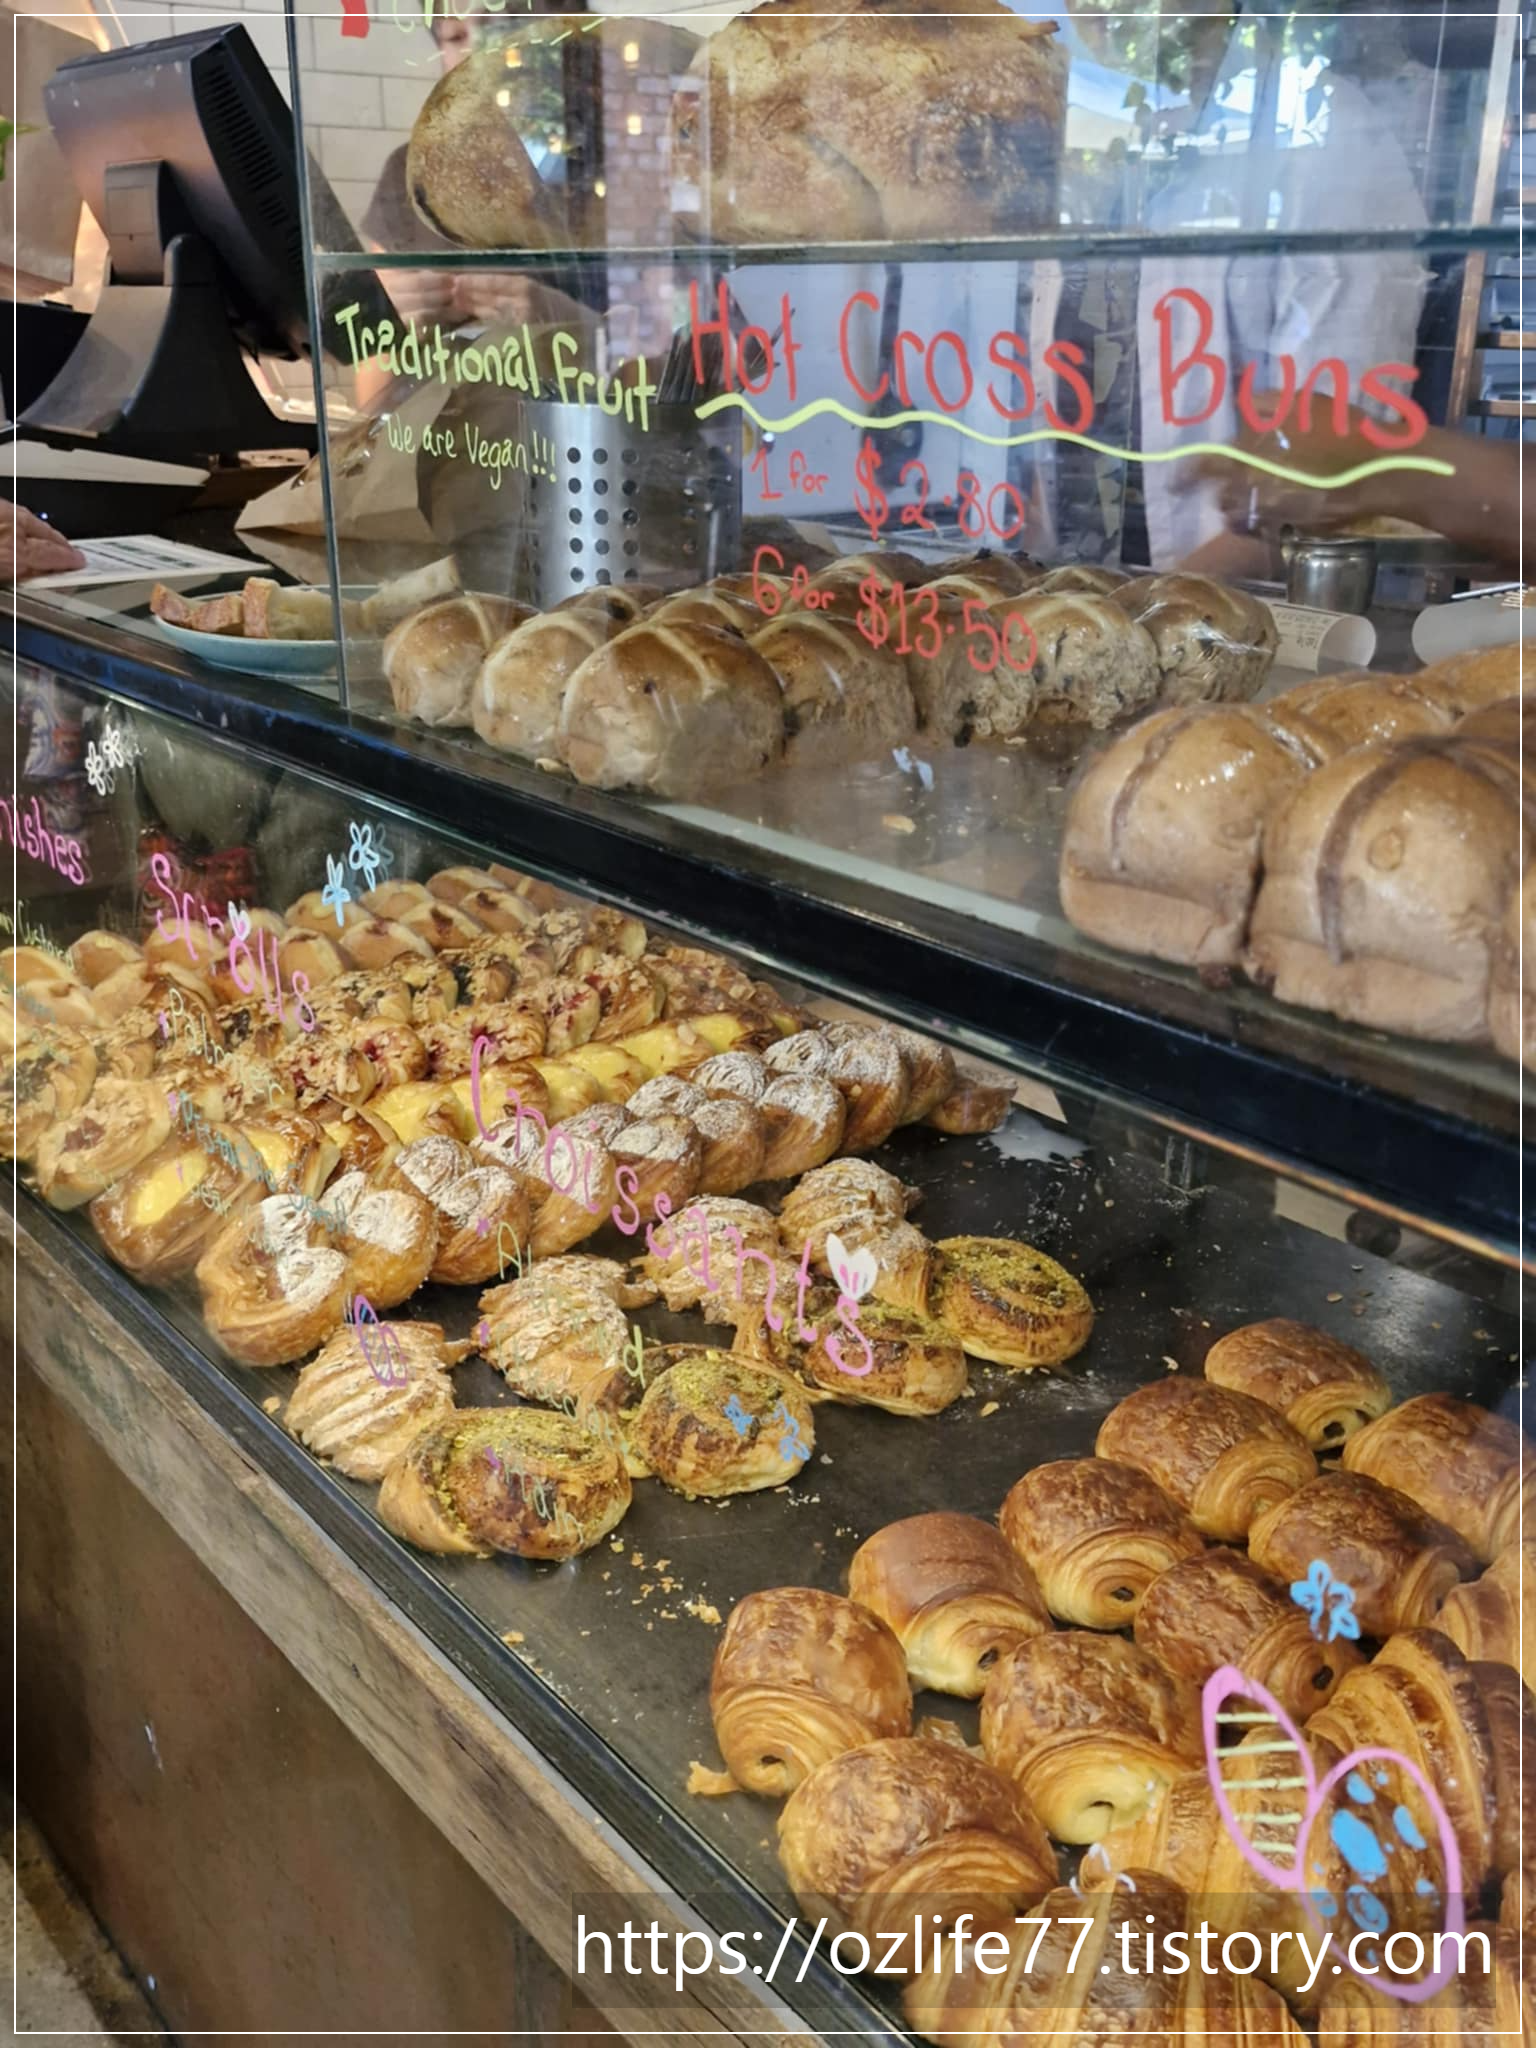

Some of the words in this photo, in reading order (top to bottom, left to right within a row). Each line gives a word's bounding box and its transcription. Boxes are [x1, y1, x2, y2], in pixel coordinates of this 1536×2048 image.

[334, 303, 540, 398] Traditional
[689, 279, 800, 401] Hot
[839, 290, 1094, 434] Cross
[1152, 287, 1430, 449] Buns
[387, 418, 417, 455] We
[421, 424, 457, 460] are
[465, 423, 557, 490] Vegan!!!
[750, 448, 784, 502] 1
[787, 450, 830, 493] for
[752, 545, 787, 617] 6
[789, 567, 836, 610] for
[470, 1035, 874, 1377] Croissants
